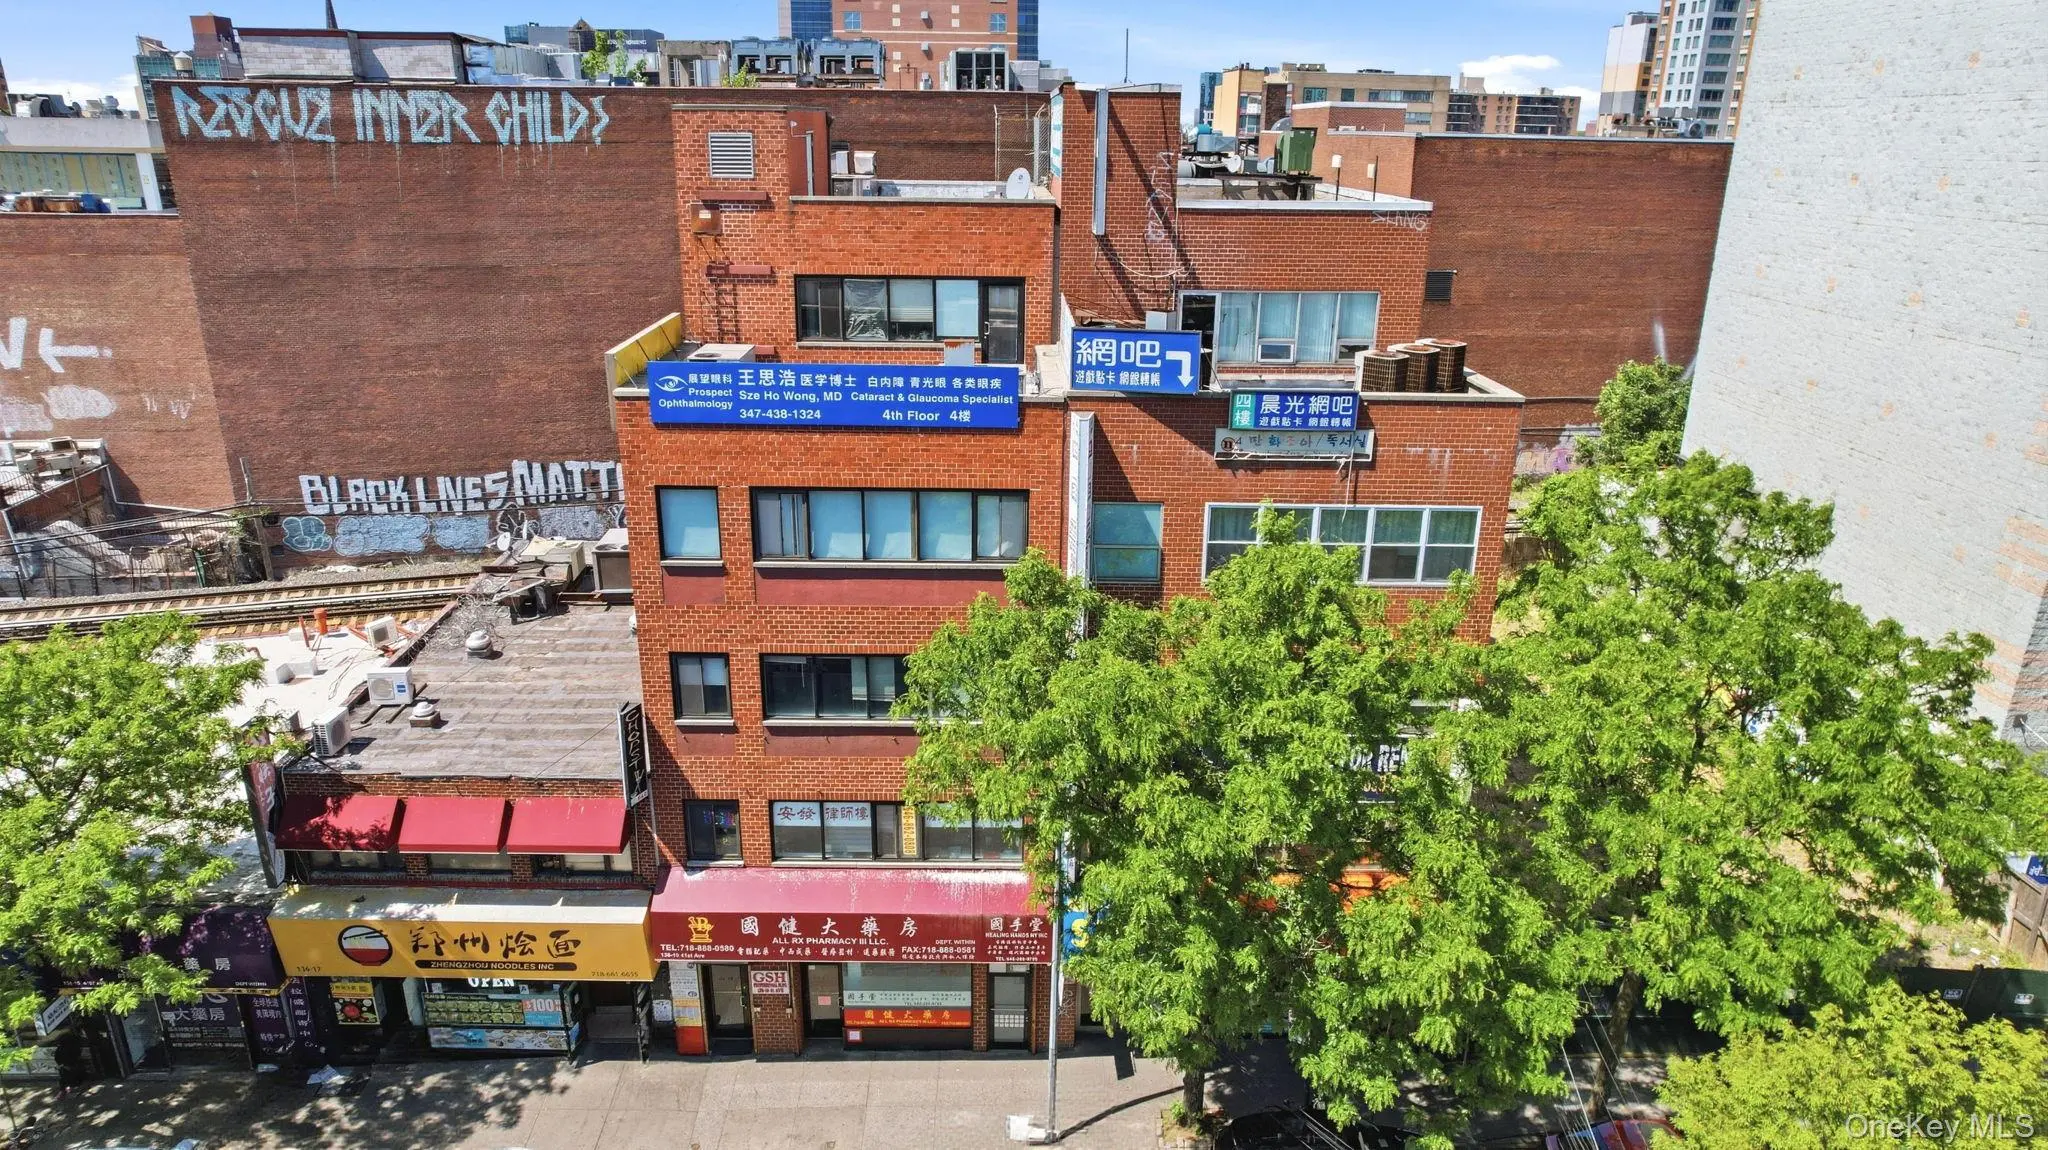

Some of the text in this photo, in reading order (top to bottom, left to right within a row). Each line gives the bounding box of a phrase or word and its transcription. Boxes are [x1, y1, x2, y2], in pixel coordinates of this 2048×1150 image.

[352, 88, 480, 143] INNER
[1076, 338, 1161, 368] 網吧
[689, 374, 732, 384] 展望眼科
[738, 369, 1002, 389] 王思浩 医学博士 白内障 青光眼 各类眼疾
[689, 388, 733, 398] Prospect
[739, 390, 1013, 405] Sze Ho Wong, MD Cataract & Glaucoma Specialist
[658, 399, 733, 410] Ophthalmology
[1260, 394, 1353, 415] 晨光網吧
[740, 409, 821, 419] 347-438-1324
[882, 409, 971, 422] 4th Floor 4楼
[299, 459, 624, 515] BLACK LIVES MATT
[741, 916, 918, 938] 國健大藥房
[431, 961, 488, 969] ZHENGZHOU
[491, 962, 536, 970] NOODLES
[753, 972, 786, 983] GSH
